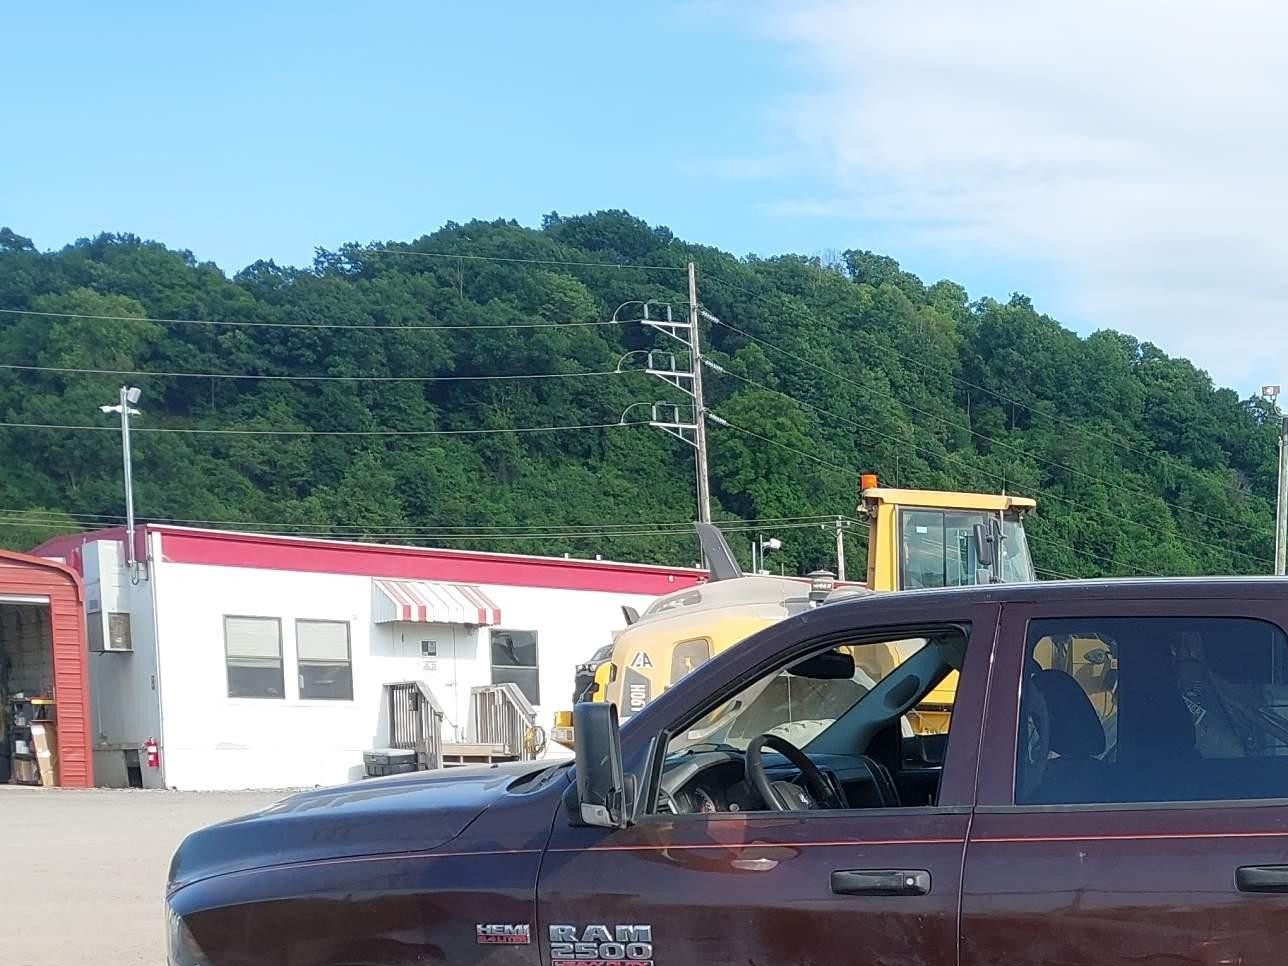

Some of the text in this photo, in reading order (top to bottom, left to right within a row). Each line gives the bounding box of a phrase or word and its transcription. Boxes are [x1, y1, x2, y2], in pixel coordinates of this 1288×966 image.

[476, 924, 530, 936] HEMI
[549, 925, 652, 942] RAM
[550, 942, 653, 960] 2500
